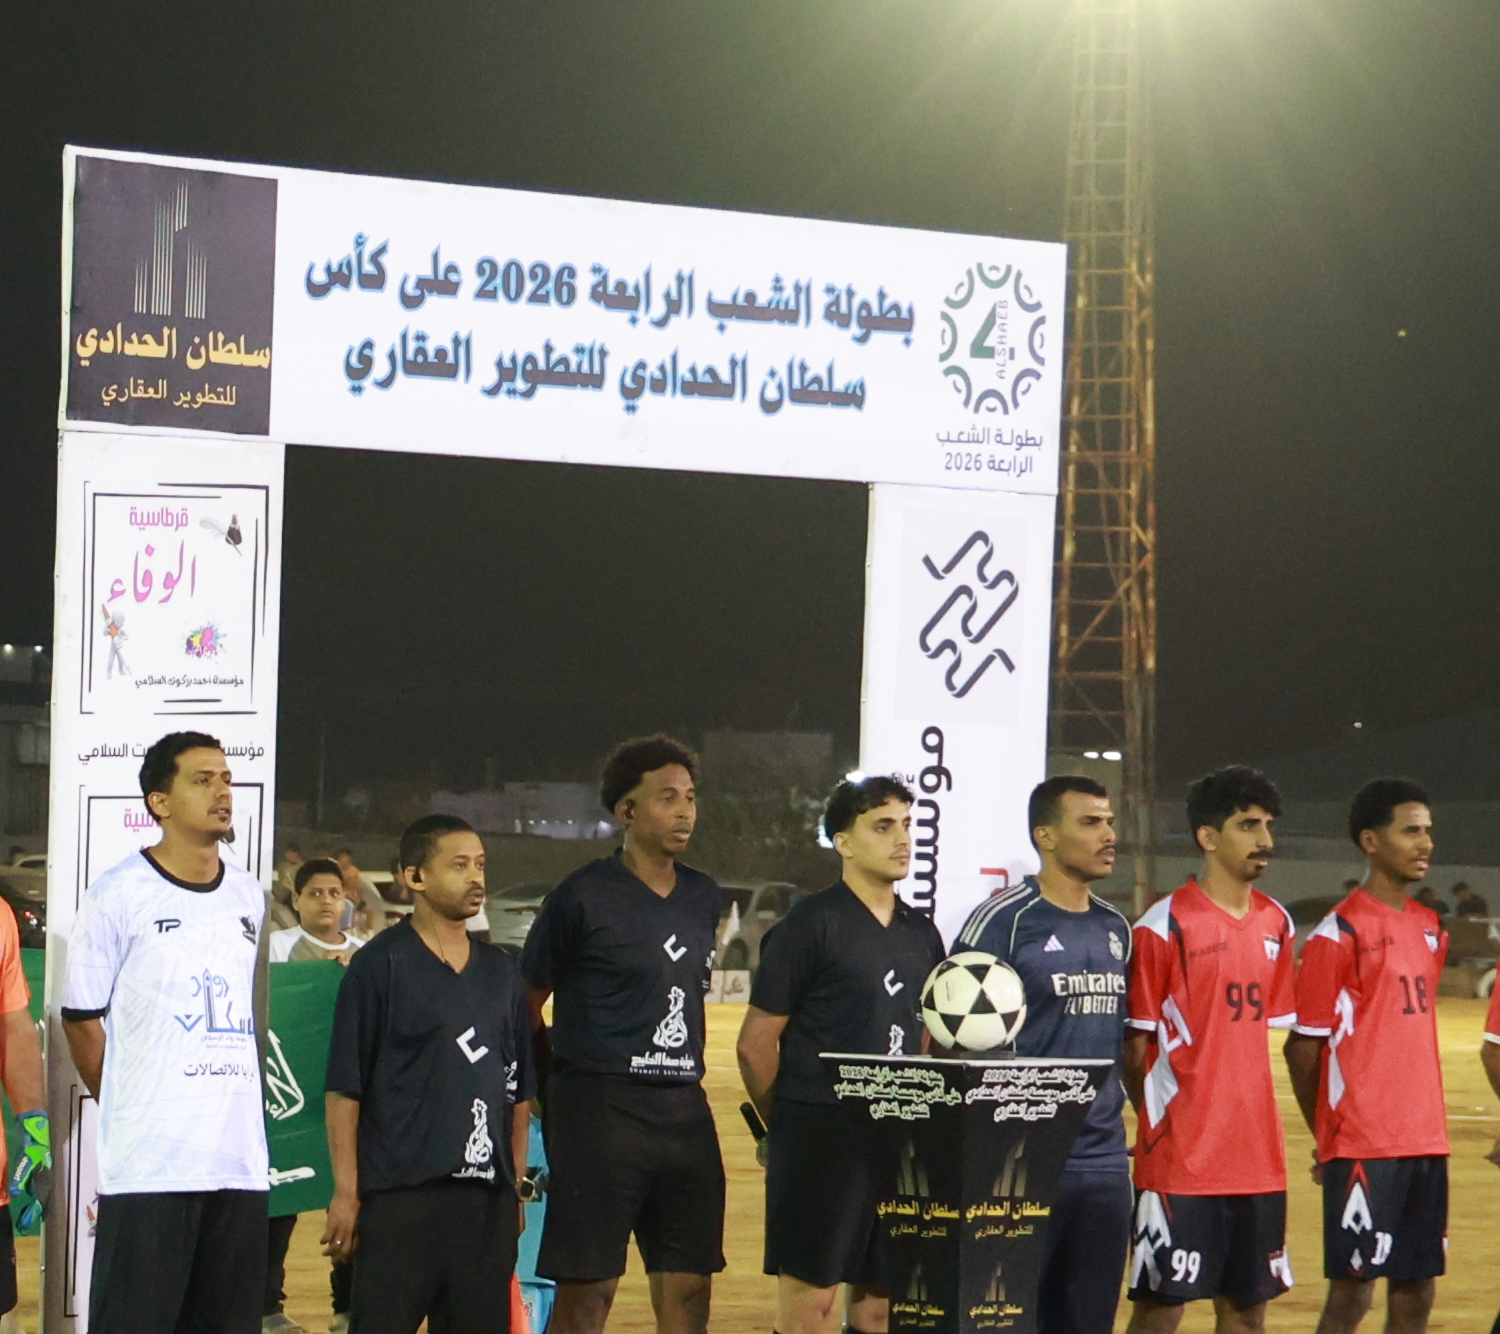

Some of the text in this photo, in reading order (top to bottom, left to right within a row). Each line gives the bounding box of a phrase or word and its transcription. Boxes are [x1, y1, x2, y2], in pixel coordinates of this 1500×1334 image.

[305, 232, 915, 349] بطولة الشعب الرابعة 2026 على كأس
[75, 322, 270, 371] سلطان الحدادي
[995, 299, 1009, 380] ALSHAEB
[345, 324, 866, 417] سلطان الحدادي للتطوير العقاري
[101, 376, 236, 408] للتطوير العقاري
[936, 424, 1043, 451] بطولة الشعب
[945, 452, 1033, 478] الرابعة 2026
[129, 506, 189, 532] قرطاسية
[106, 539, 196, 604] الوفاء
[78, 743, 128, 765] السلامي
[1051, 969, 1126, 997] Emirates
[1226, 981, 1264, 1022] 99
[877, 1200, 960, 1220] سلطان الحدادي
[965, 1201, 1050, 1223] سلطان الحدادي
[1171, 1247, 1202, 1285] 99
